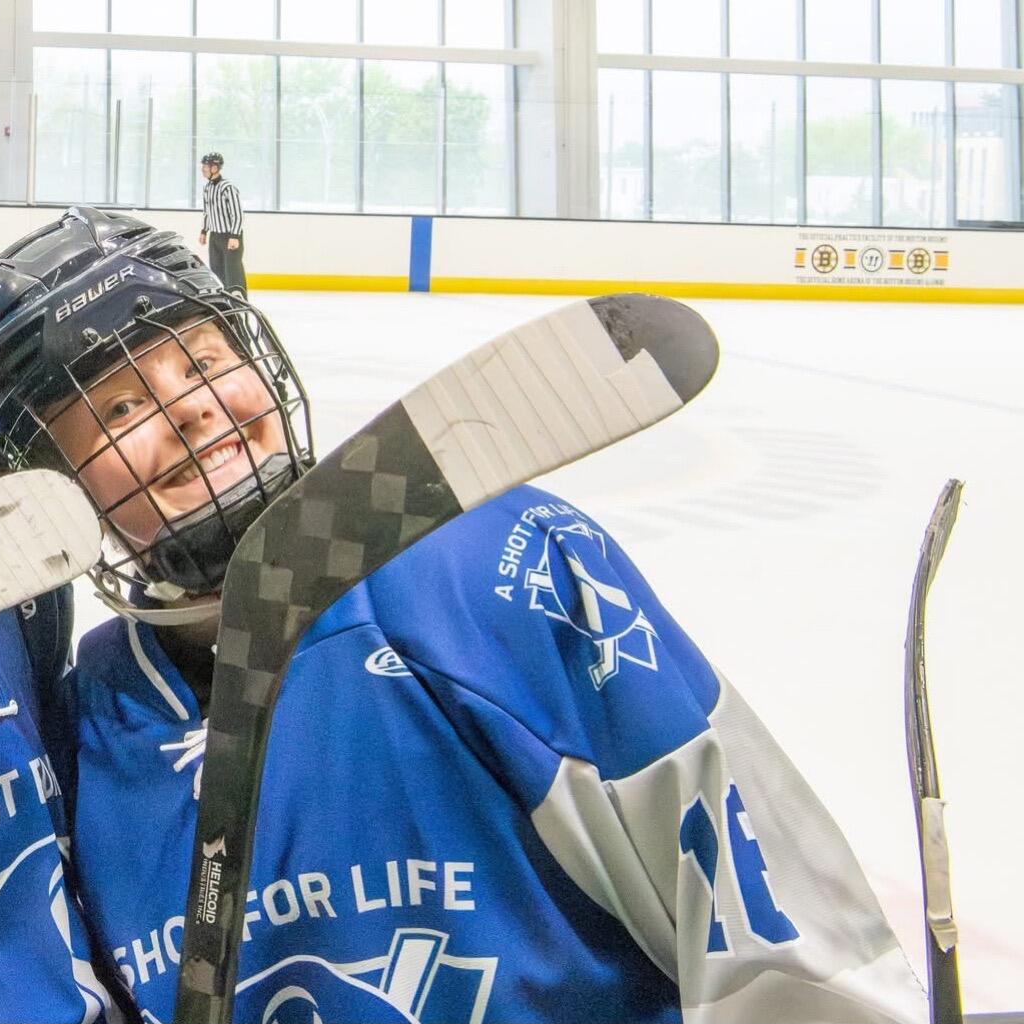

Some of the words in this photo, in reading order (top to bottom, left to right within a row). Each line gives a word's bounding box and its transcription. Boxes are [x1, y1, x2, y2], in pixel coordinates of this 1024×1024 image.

[55, 264, 137, 324] BAUER
[498, 522, 534, 578] SHOT
[494, 585, 513, 602] A
[205, 861, 223, 924] HELICOID
[113, 915, 186, 990] SHO
[242, 872, 337, 942] FOR
[351, 858, 476, 914] LIFE
